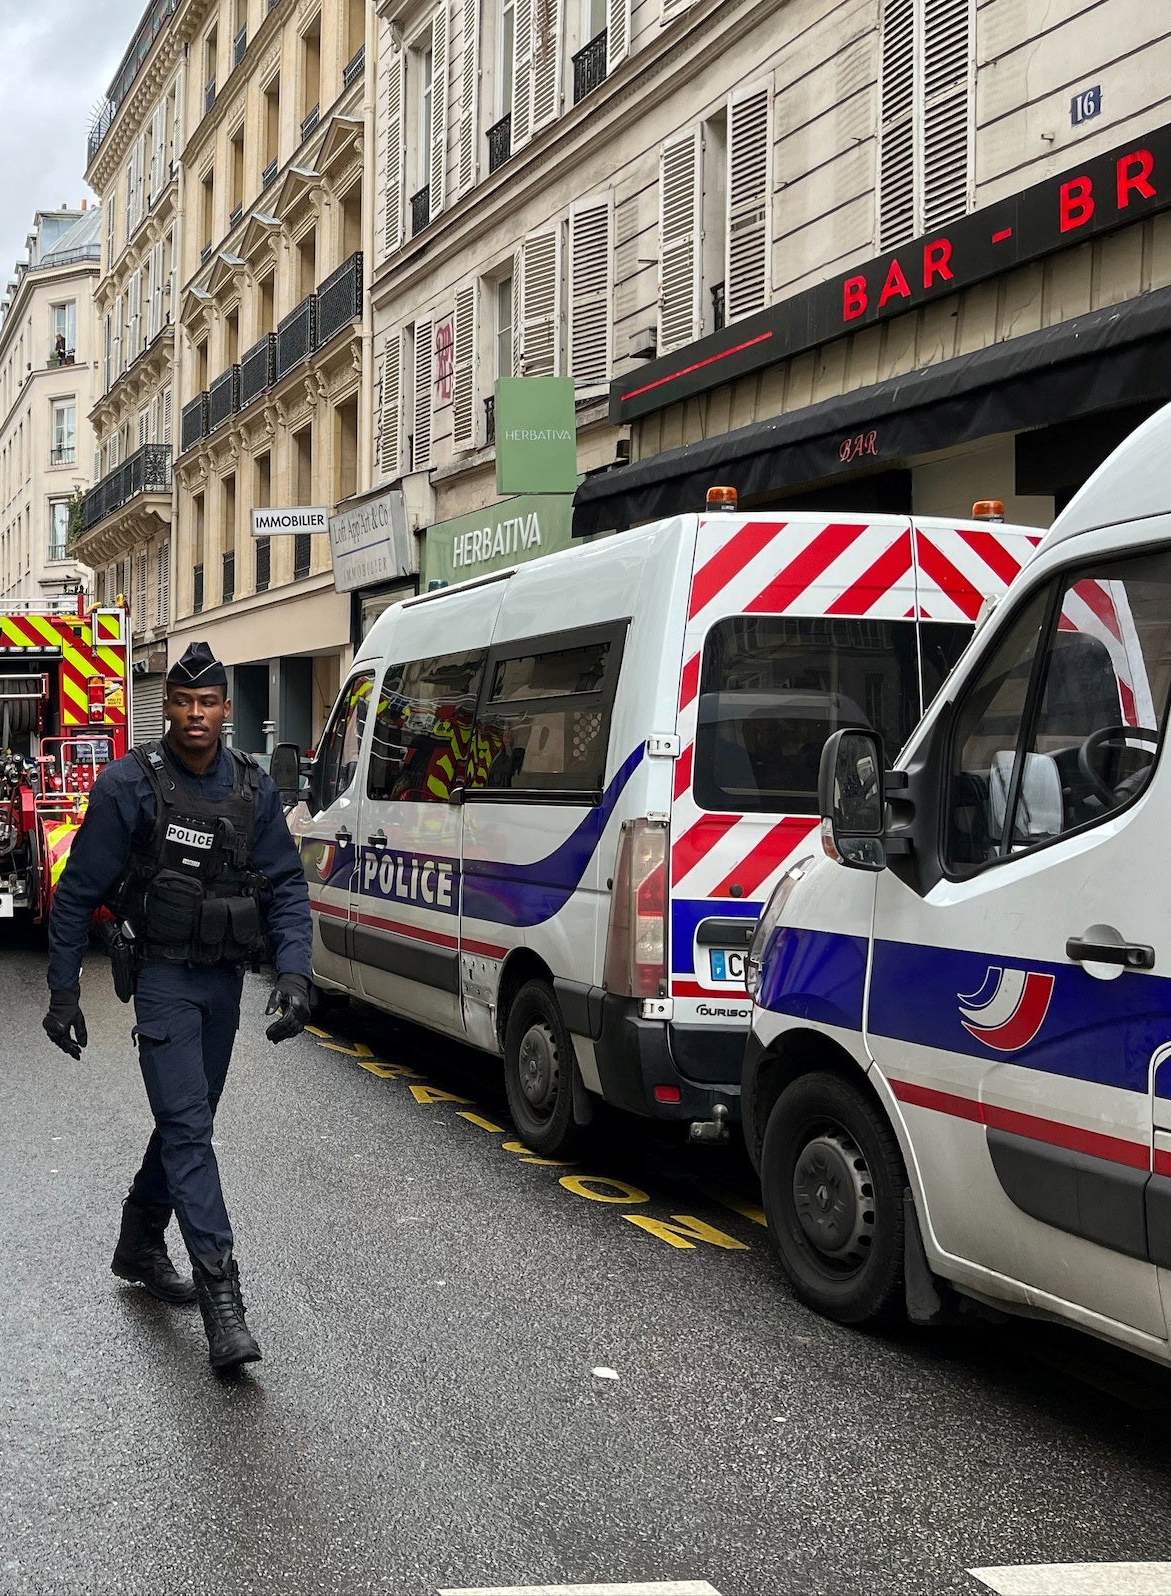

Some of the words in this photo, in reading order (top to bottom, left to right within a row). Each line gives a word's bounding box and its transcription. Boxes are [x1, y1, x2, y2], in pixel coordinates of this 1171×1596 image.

[1076, 90, 1095, 122] 16
[843, 237, 955, 322] BAR
[1059, 149, 1157, 233] BR
[505, 429, 572, 441] HERBATIVA
[839, 430, 878, 463] BAR
[256, 514, 324, 528] IMMOBILIER
[332, 519, 347, 544] Loft
[378, 504, 388, 527] Co
[453, 511, 541, 568] HERBATIVA
[343, 557, 387, 581] IMMOBILIER
[168, 827, 213, 846] POLICE
[364, 852, 453, 907] POLICE
